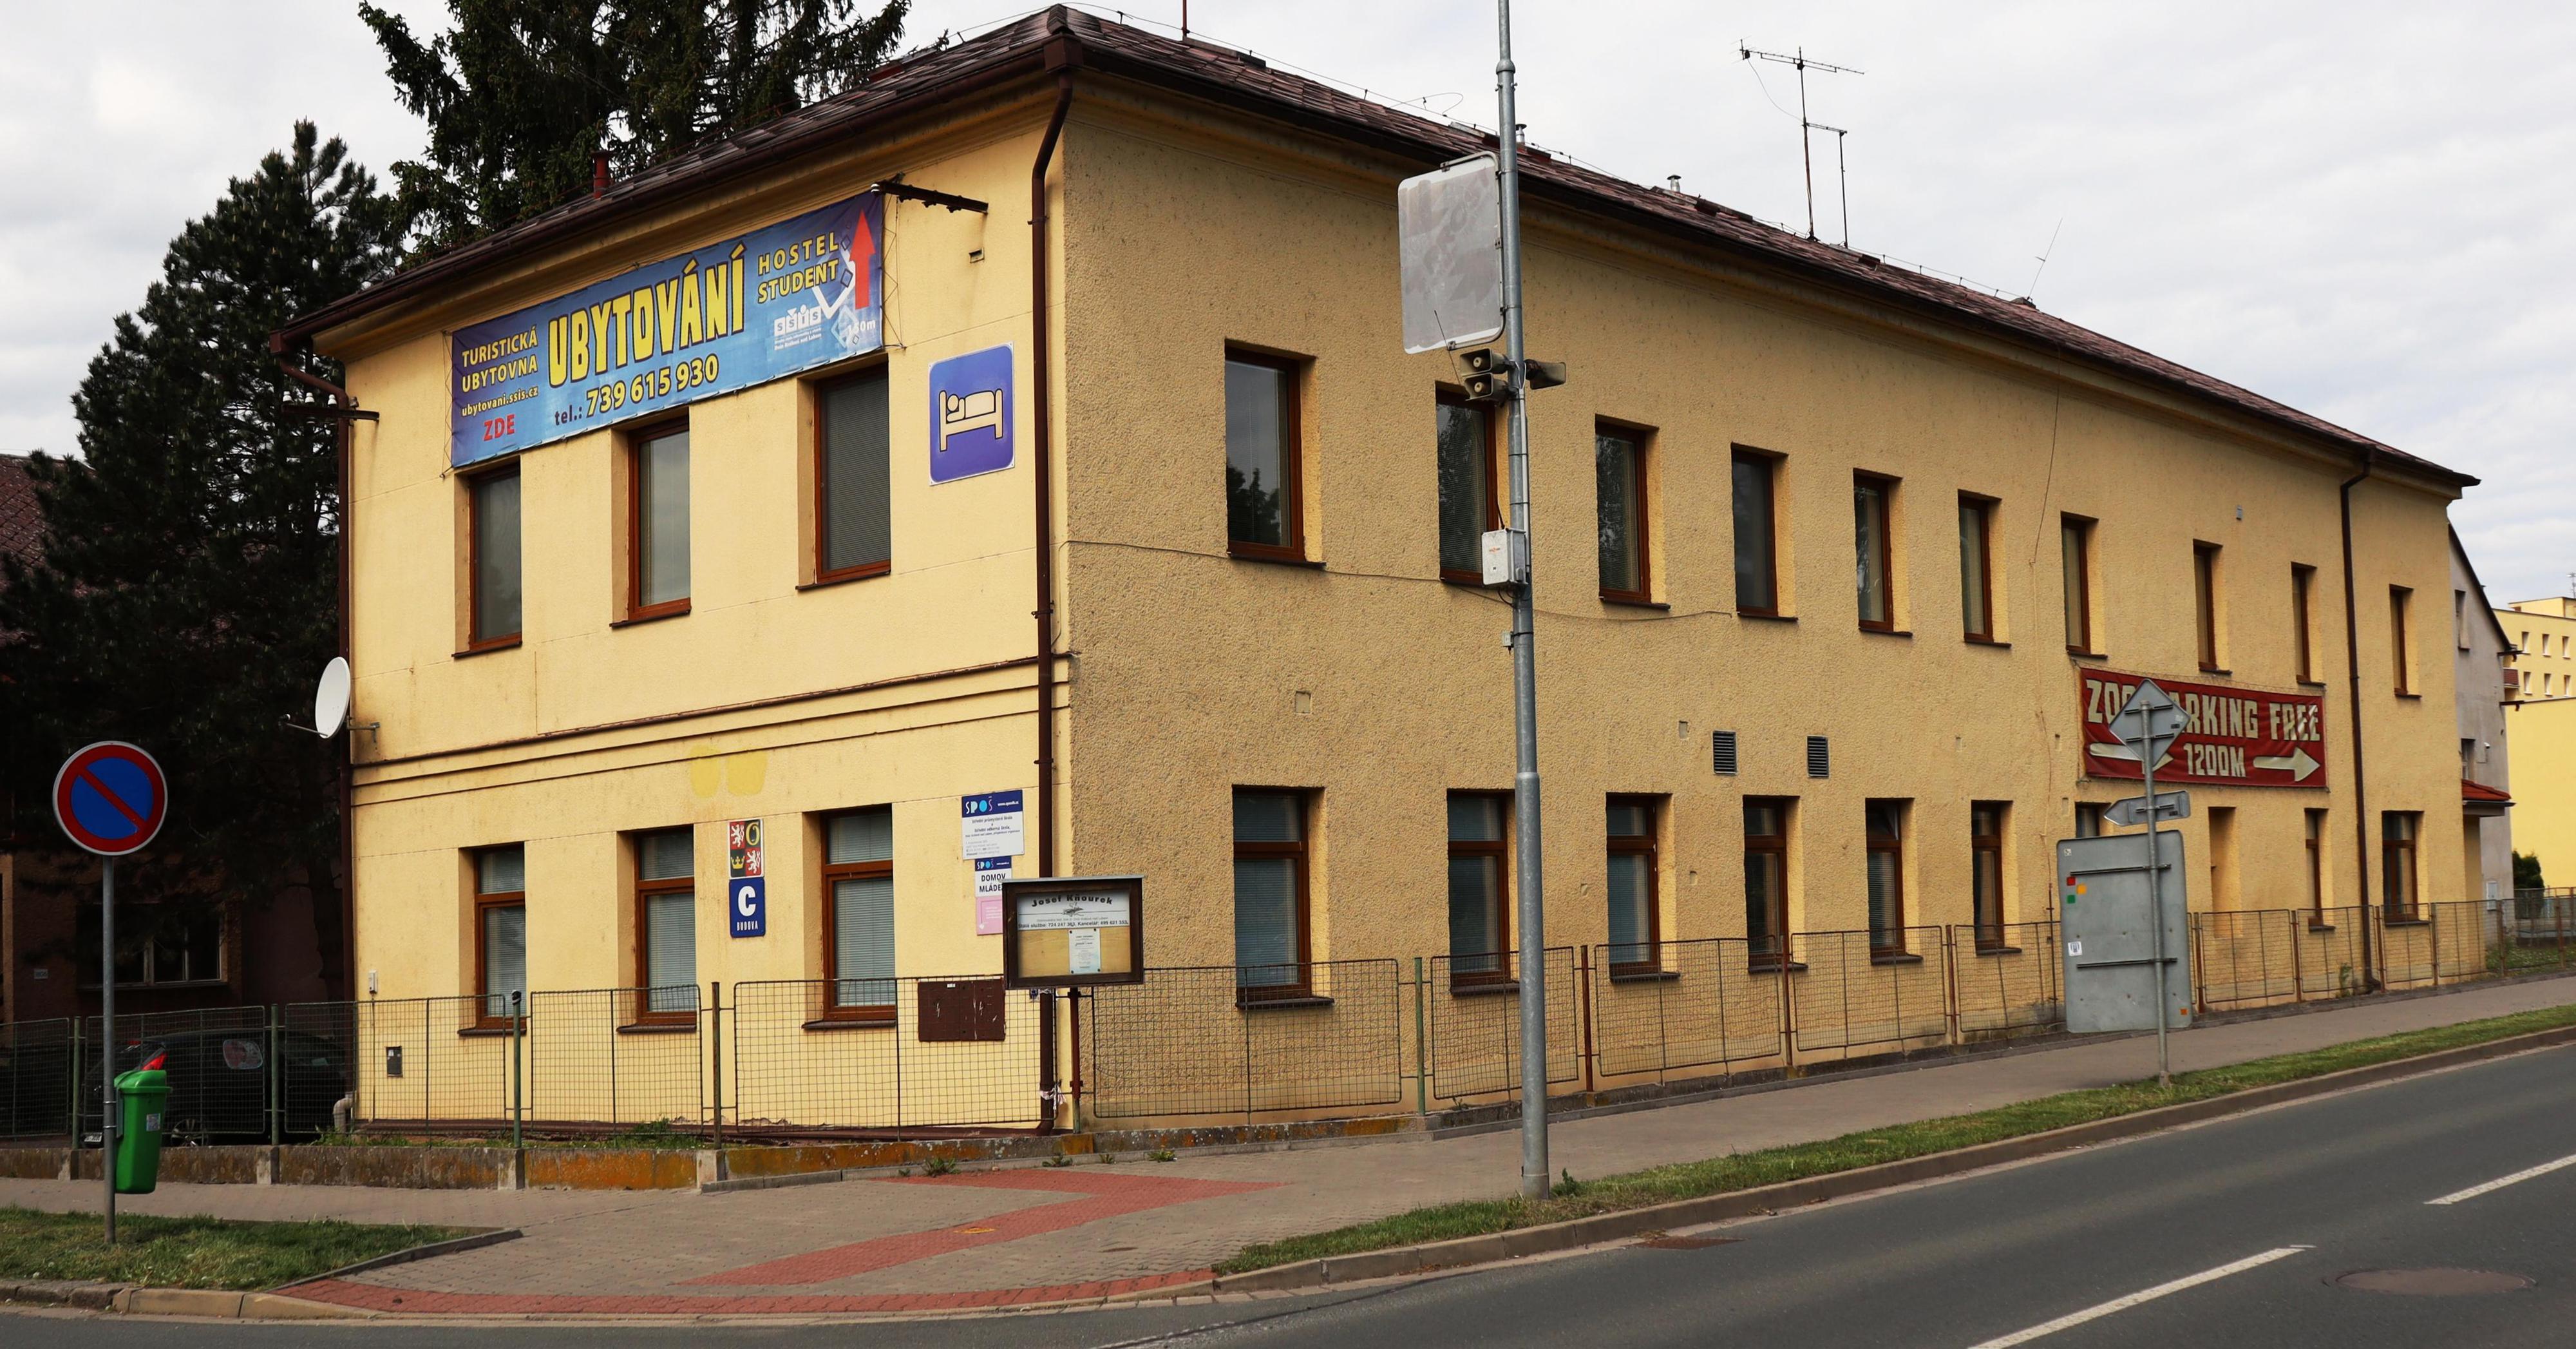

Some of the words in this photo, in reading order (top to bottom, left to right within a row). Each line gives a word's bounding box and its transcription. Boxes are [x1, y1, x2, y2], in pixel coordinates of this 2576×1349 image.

[758, 231, 839, 276] HOSTEL
[758, 258, 839, 304] STUDENT
[548, 242, 746, 388] UBYTOVÁNÍ
[462, 324, 538, 368] TURISTICKÁ
[462, 354, 538, 392] UBYTOVNA
[554, 405, 582, 426] tel.:
[587, 380, 626, 418] 739
[630, 366, 670, 404] 615
[675, 353, 719, 392] 930
[462, 387, 539, 417] ubytovani.ssis.cz
[484, 414, 515, 441] ZDE
[2168, 691, 2259, 739] RKING
[2269, 702, 2321, 741] FREE
[2183, 743, 2246, 778] 1200M
[979, 882, 1003, 893] MLÁDE
[981, 873, 1006, 882] DOMOV
[738, 885, 757, 917] C
[1031, 895, 1062, 907] Josef
[737, 921, 758, 931] BUDOVA
